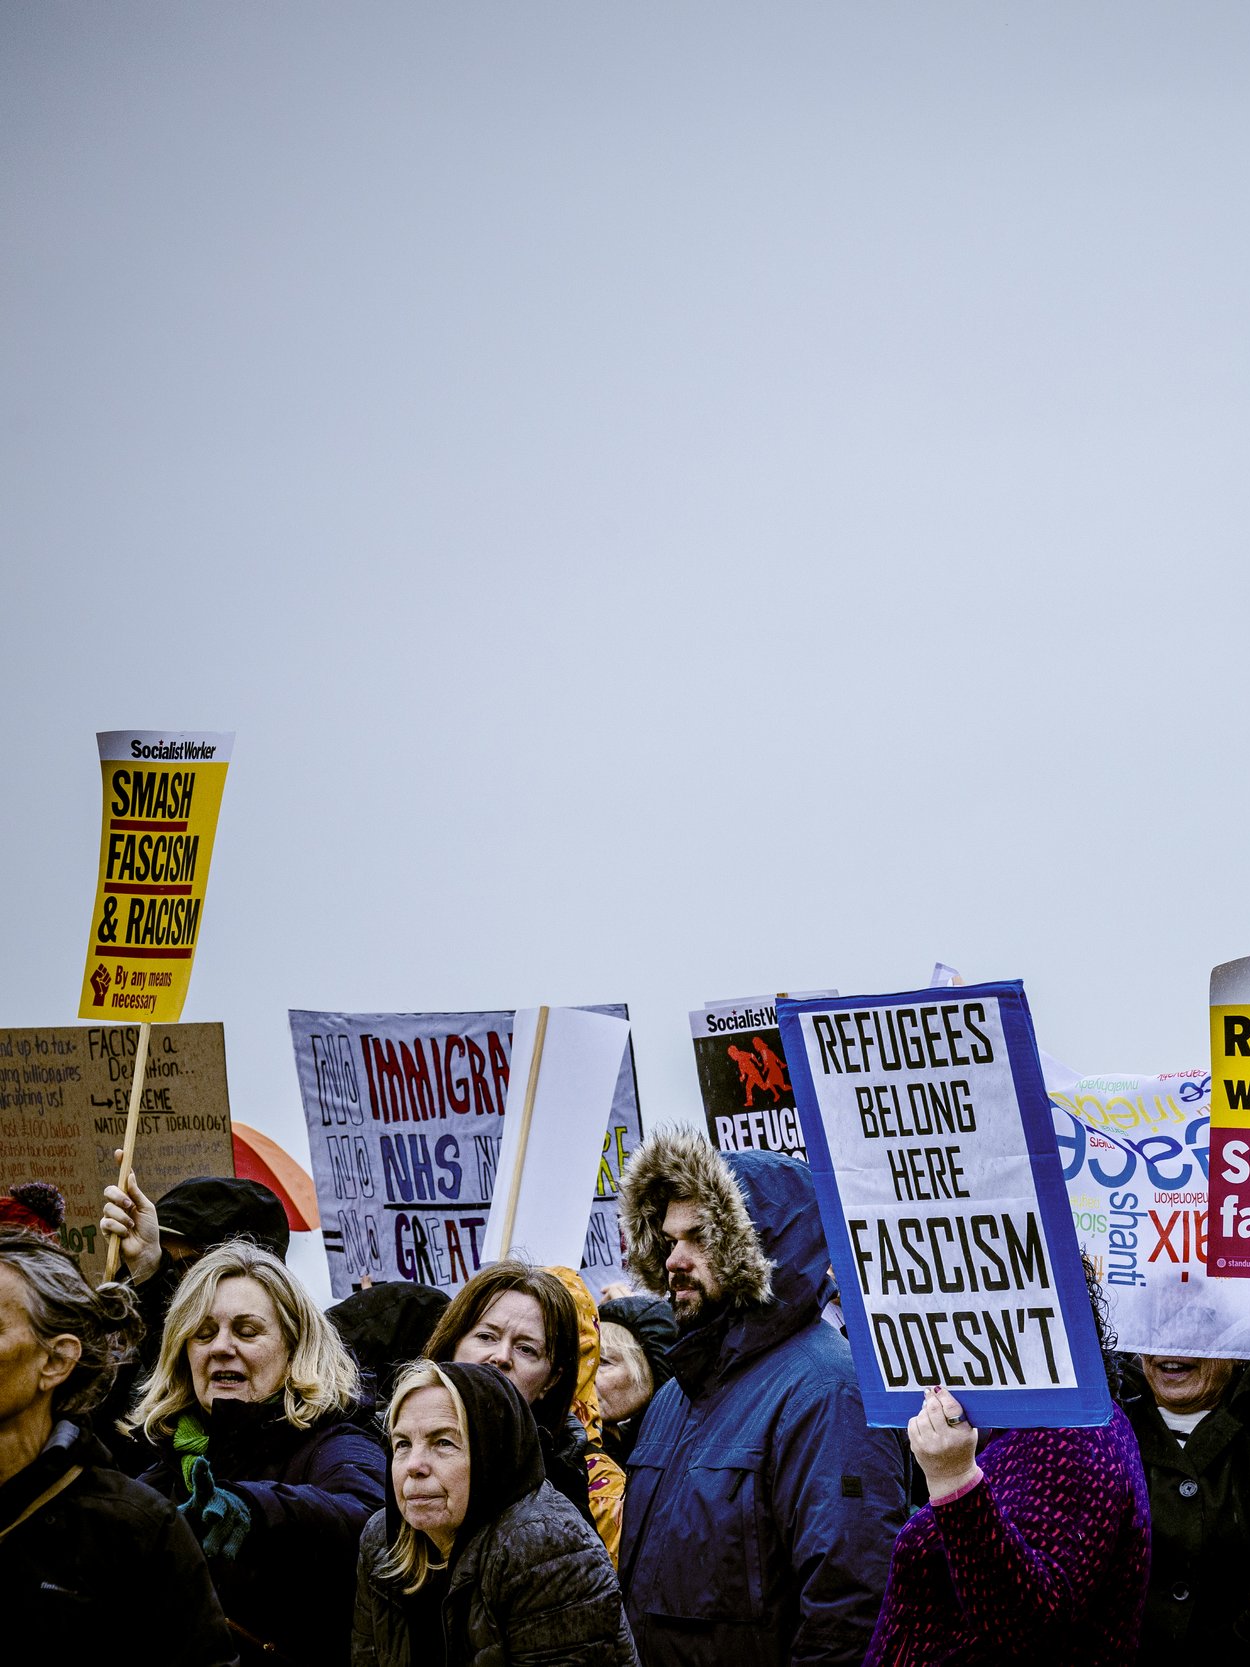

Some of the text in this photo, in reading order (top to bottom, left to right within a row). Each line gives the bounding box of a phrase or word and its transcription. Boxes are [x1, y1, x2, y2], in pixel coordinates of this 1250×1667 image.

[111, 769, 196, 819] SMASH
[106, 833, 200, 882] FASCISM
[97, 895, 201, 945] & RACISM
[112, 992, 158, 1014] necessary
[115, 965, 172, 989] By any means
[35, 1034, 48, 1055] to
[163, 1036, 177, 1054] a
[811, 1002, 995, 1075] REFUGEES
[114, 1088, 172, 1110] EXREME
[311, 1031, 513, 1126] NO IMMIGRA
[715, 1107, 806, 1150] REFUG
[855, 1080, 977, 1139] BELONG
[326, 1135, 375, 1199] NO
[380, 1133, 463, 1202] NHS
[887, 1146, 971, 1201] HERE
[395, 1213, 486, 1286] GREAT
[847, 1211, 1050, 1296] FASCISM
[1107, 1191, 1148, 1287] shanti
[871, 1307, 1060, 1388] DOESN'T
